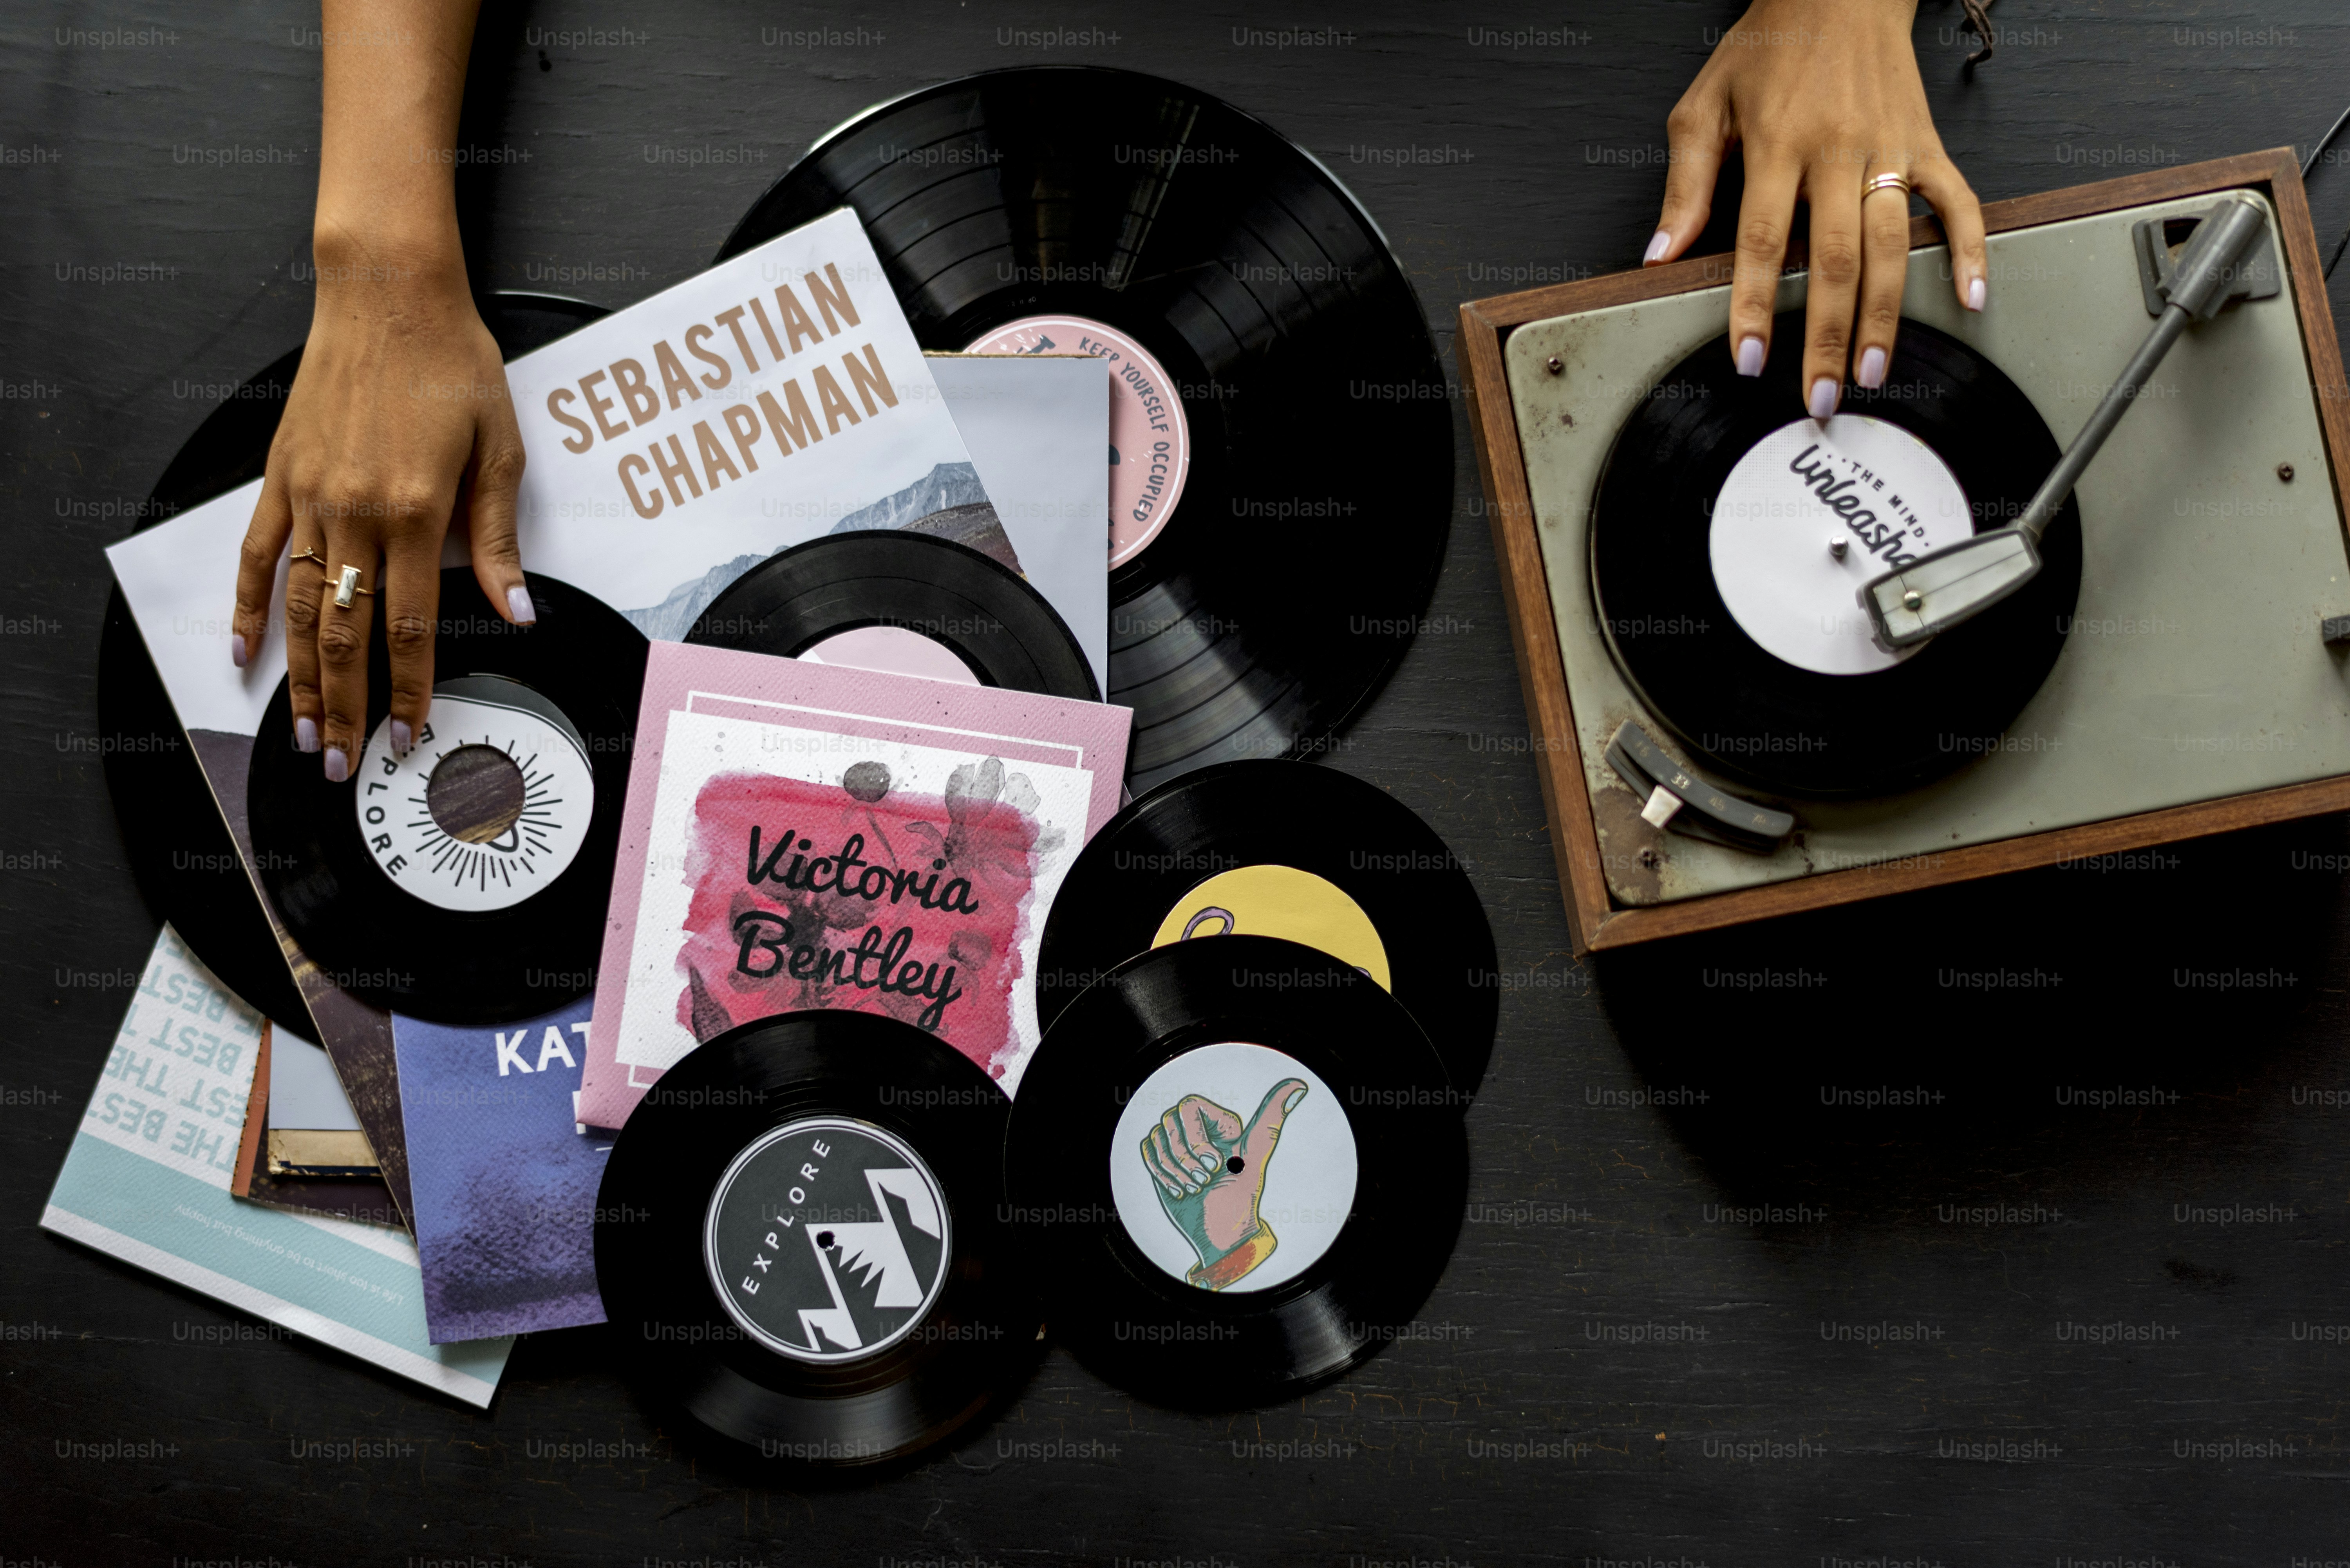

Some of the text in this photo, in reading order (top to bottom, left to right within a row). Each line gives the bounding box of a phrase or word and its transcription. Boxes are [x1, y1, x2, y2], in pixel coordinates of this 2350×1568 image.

[547, 262, 861, 454] SEBASTIAN
[618, 343, 899, 519] CHAPMAN
[1079, 337, 1170, 522] KEEP YOURSELF OCCUPIED
[1851, 461, 1884, 491] THE
[366, 723, 435, 876] EPLORE
[746, 825, 980, 915] Victoria
[139, 965, 232, 1023] BEST
[733, 910, 962, 1032] Bentley
[148, 1017, 242, 1077] BEST
[179, 1078, 249, 1129] EST
[170, 1120, 238, 1174] THE
[213, 1220, 233, 1236] but
[235, 1227, 284, 1255] anything
[741, 1139, 831, 1295] EXPLORE
[287, 1250, 301, 1264] be
[303, 1257, 315, 1268] to
[317, 1262, 347, 1281] short
[349, 1276, 368, 1290] too
[371, 1284, 381, 1297] is
[382, 1289, 403, 1305] Life
